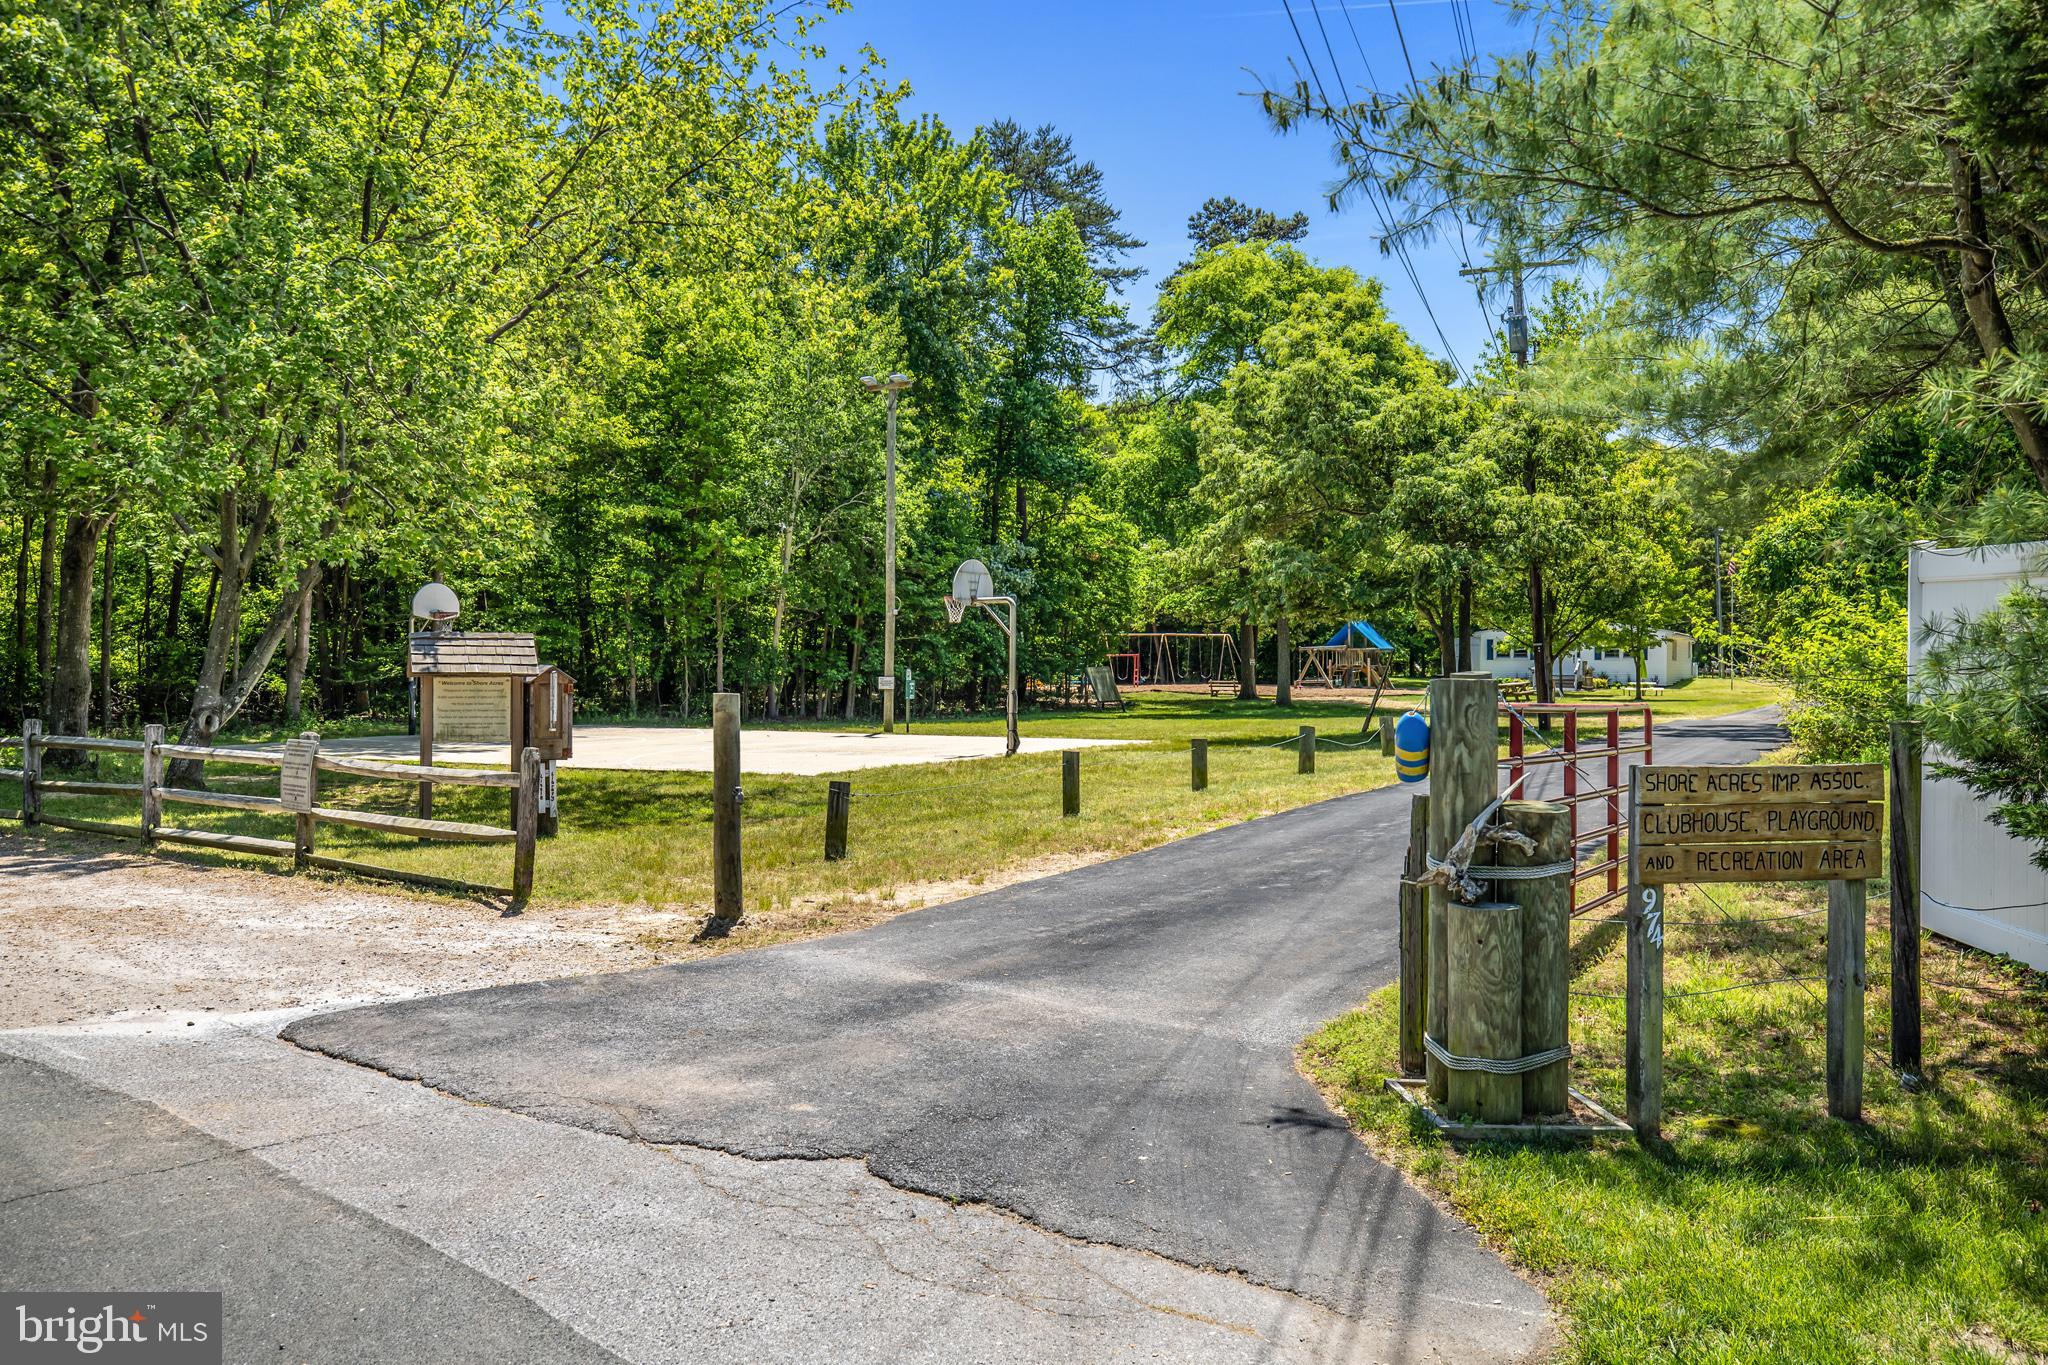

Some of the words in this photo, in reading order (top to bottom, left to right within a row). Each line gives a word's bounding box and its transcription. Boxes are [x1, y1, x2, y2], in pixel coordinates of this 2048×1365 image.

[1645, 773, 1699, 793] SHORE
[1706, 773, 1763, 793] ACRES
[1771, 773, 1801, 793] IMP.
[1810, 771, 1870, 790] ASSOC.
[1645, 855, 1674, 870] AND
[1697, 851, 1804, 872] RECREATION
[1819, 849, 1867, 869] AREA
[1642, 888, 1665, 950] 974
